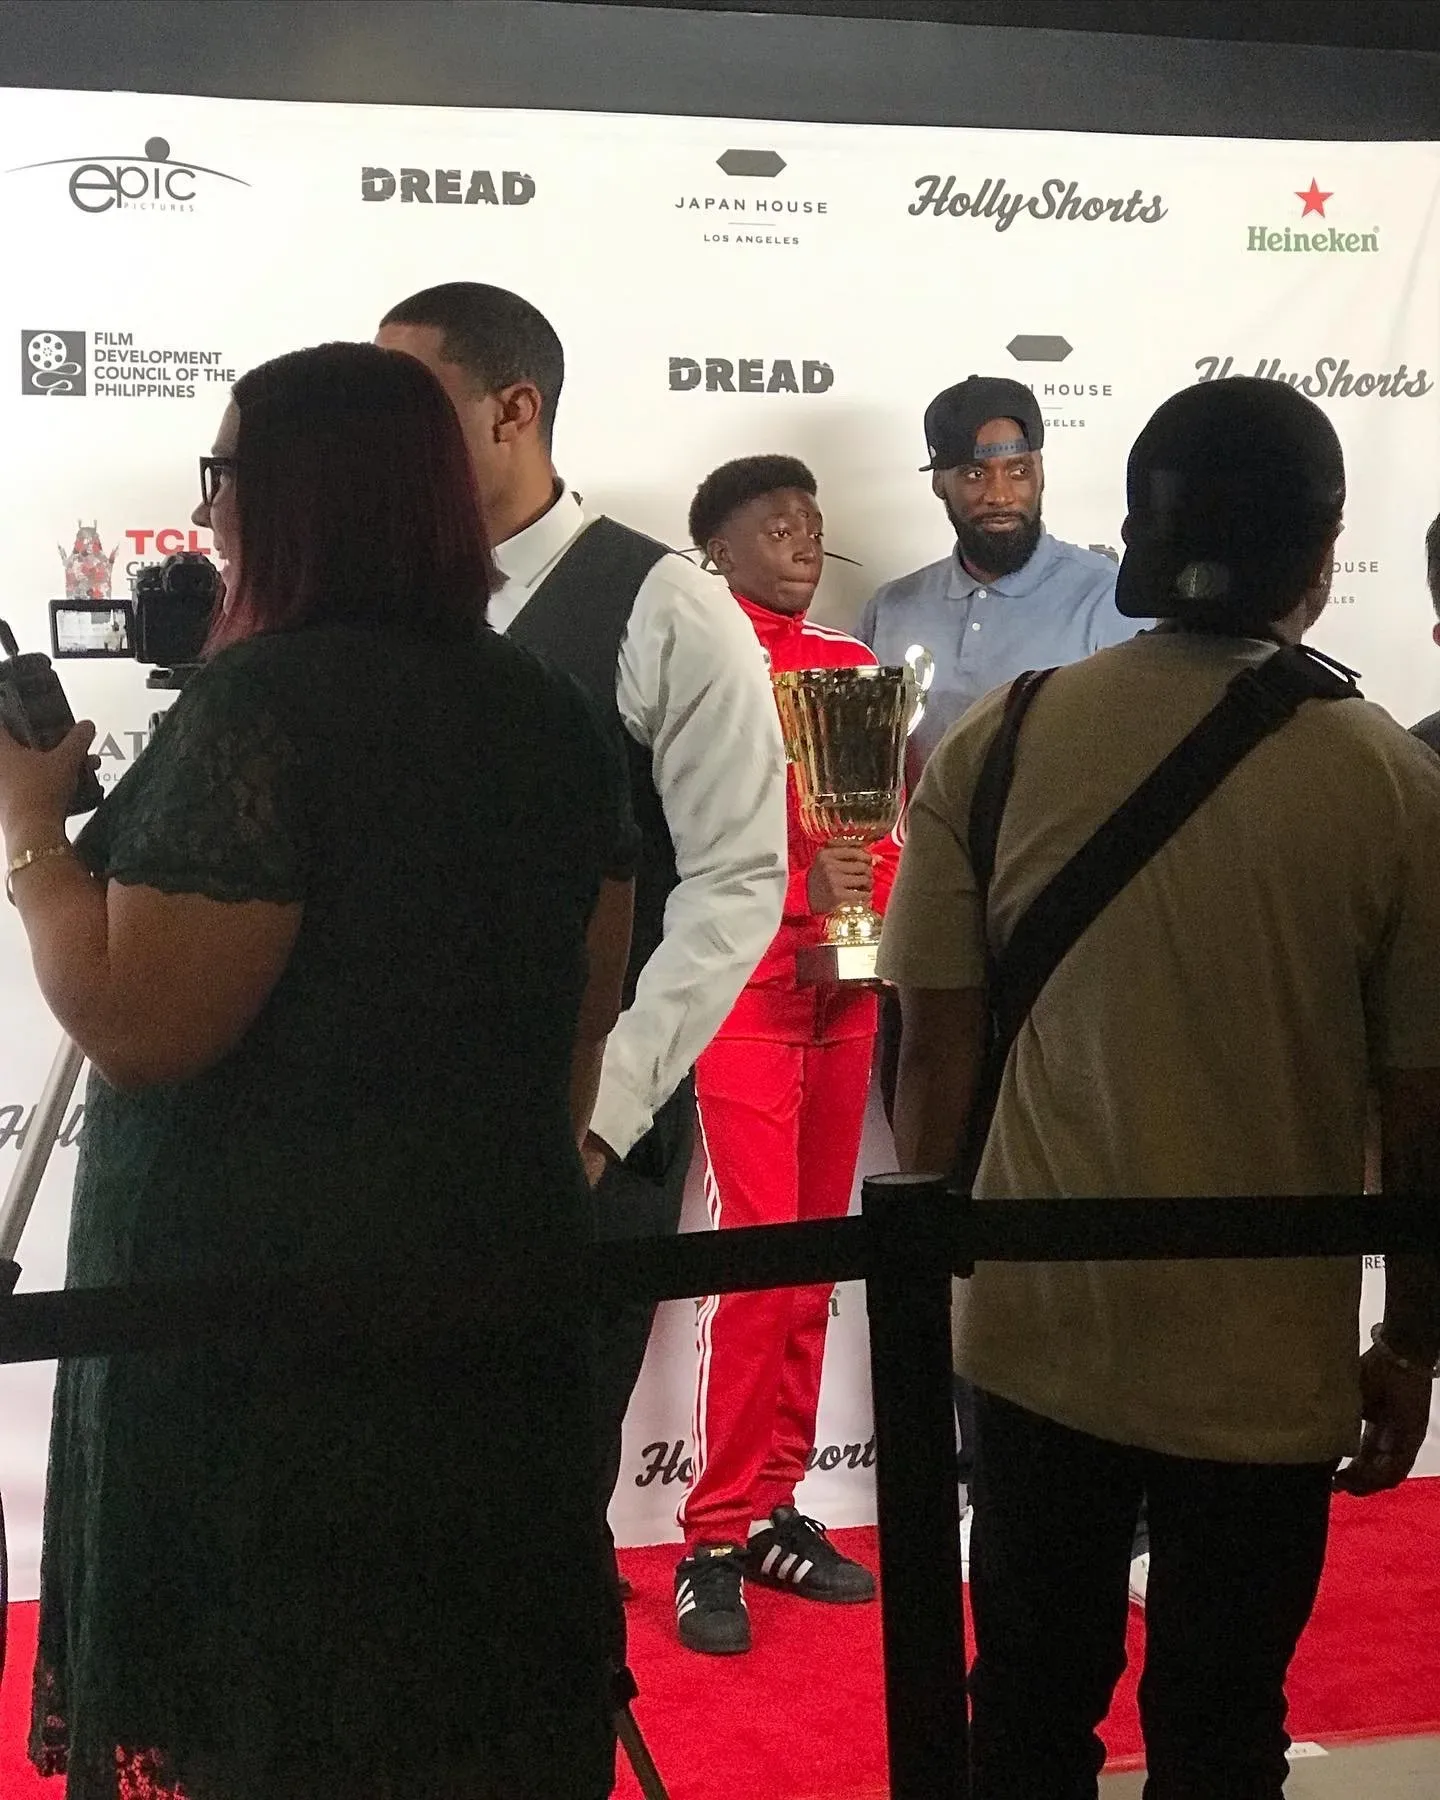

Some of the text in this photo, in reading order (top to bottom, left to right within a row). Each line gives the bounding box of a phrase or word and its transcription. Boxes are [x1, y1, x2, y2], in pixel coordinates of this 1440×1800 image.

[362, 166, 536, 207] DREAD
[123, 202, 194, 212] PICTURES
[674, 196, 828, 214] JAPAN HOUSE
[703, 233, 799, 245] LOS ANGELES
[94, 331, 134, 346] FILM
[94, 348, 223, 365] DEVELOPMENT
[94, 366, 236, 382] COUNCIL OF THE
[668, 356, 835, 394] DREAD
[94, 383, 196, 398] PHILIPPINES
[1044, 383, 1113, 396] HOUSE
[1043, 419, 1085, 427] GELES
[125, 528, 211, 555] TCL
[1333, 561, 1379, 573] OUSE
